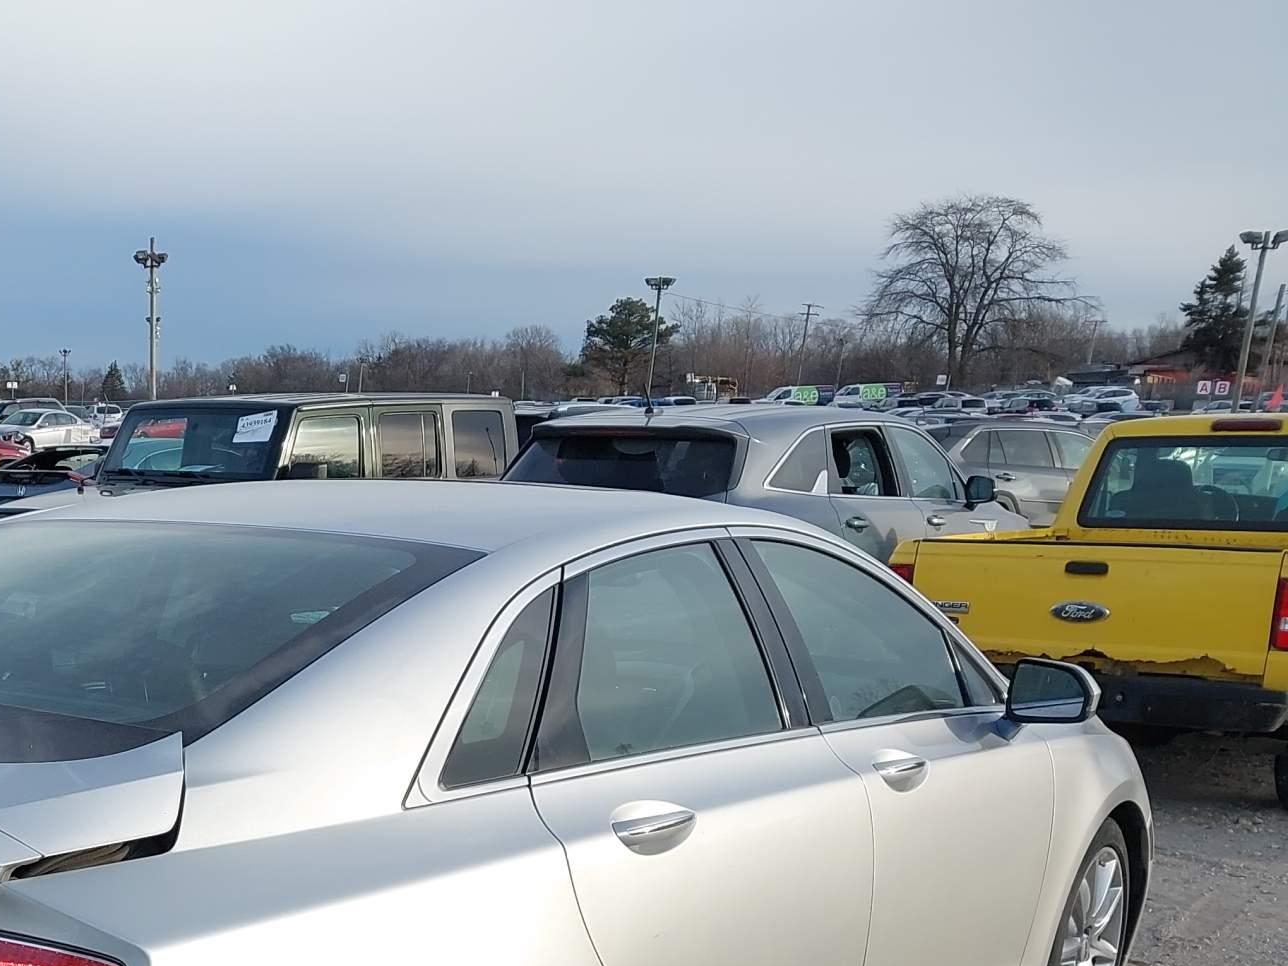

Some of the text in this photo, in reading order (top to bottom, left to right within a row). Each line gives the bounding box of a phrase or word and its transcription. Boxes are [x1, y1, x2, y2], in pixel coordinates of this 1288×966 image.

[794, 388, 818, 402] a&e
[862, 386, 887, 400] a&e
[1062, 604, 1096, 618] Ford
